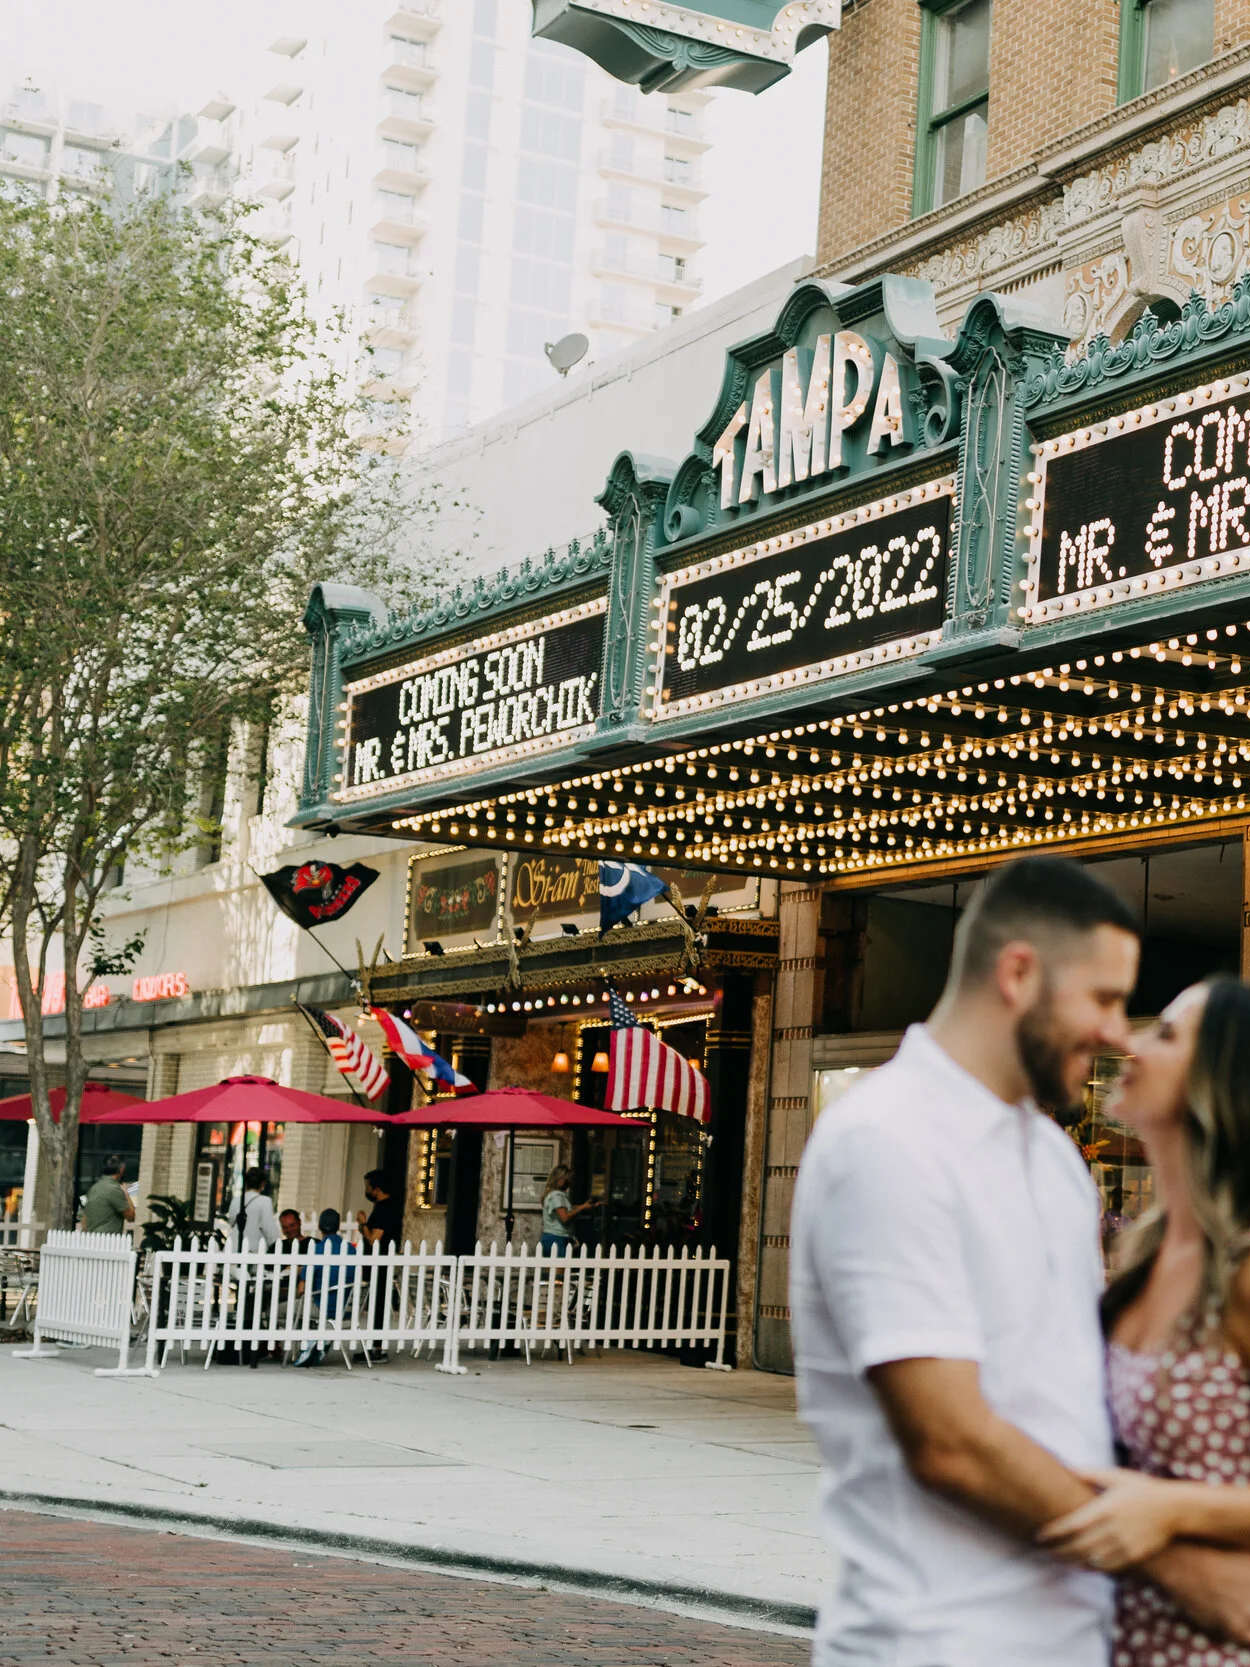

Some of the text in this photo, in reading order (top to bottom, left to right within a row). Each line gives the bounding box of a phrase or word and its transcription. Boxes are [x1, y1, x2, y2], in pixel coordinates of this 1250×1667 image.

[711, 330, 910, 511] TAMPA
[677, 525, 941, 672] 02/25/2022
[1057, 516, 1128, 595] MR.
[1144, 500, 1175, 568] &
[354, 671, 597, 785] MR. & MRS. PEWORCHIK
[399, 636, 546, 726] COMING SOON
[132, 972, 188, 1003] LIQUORS
